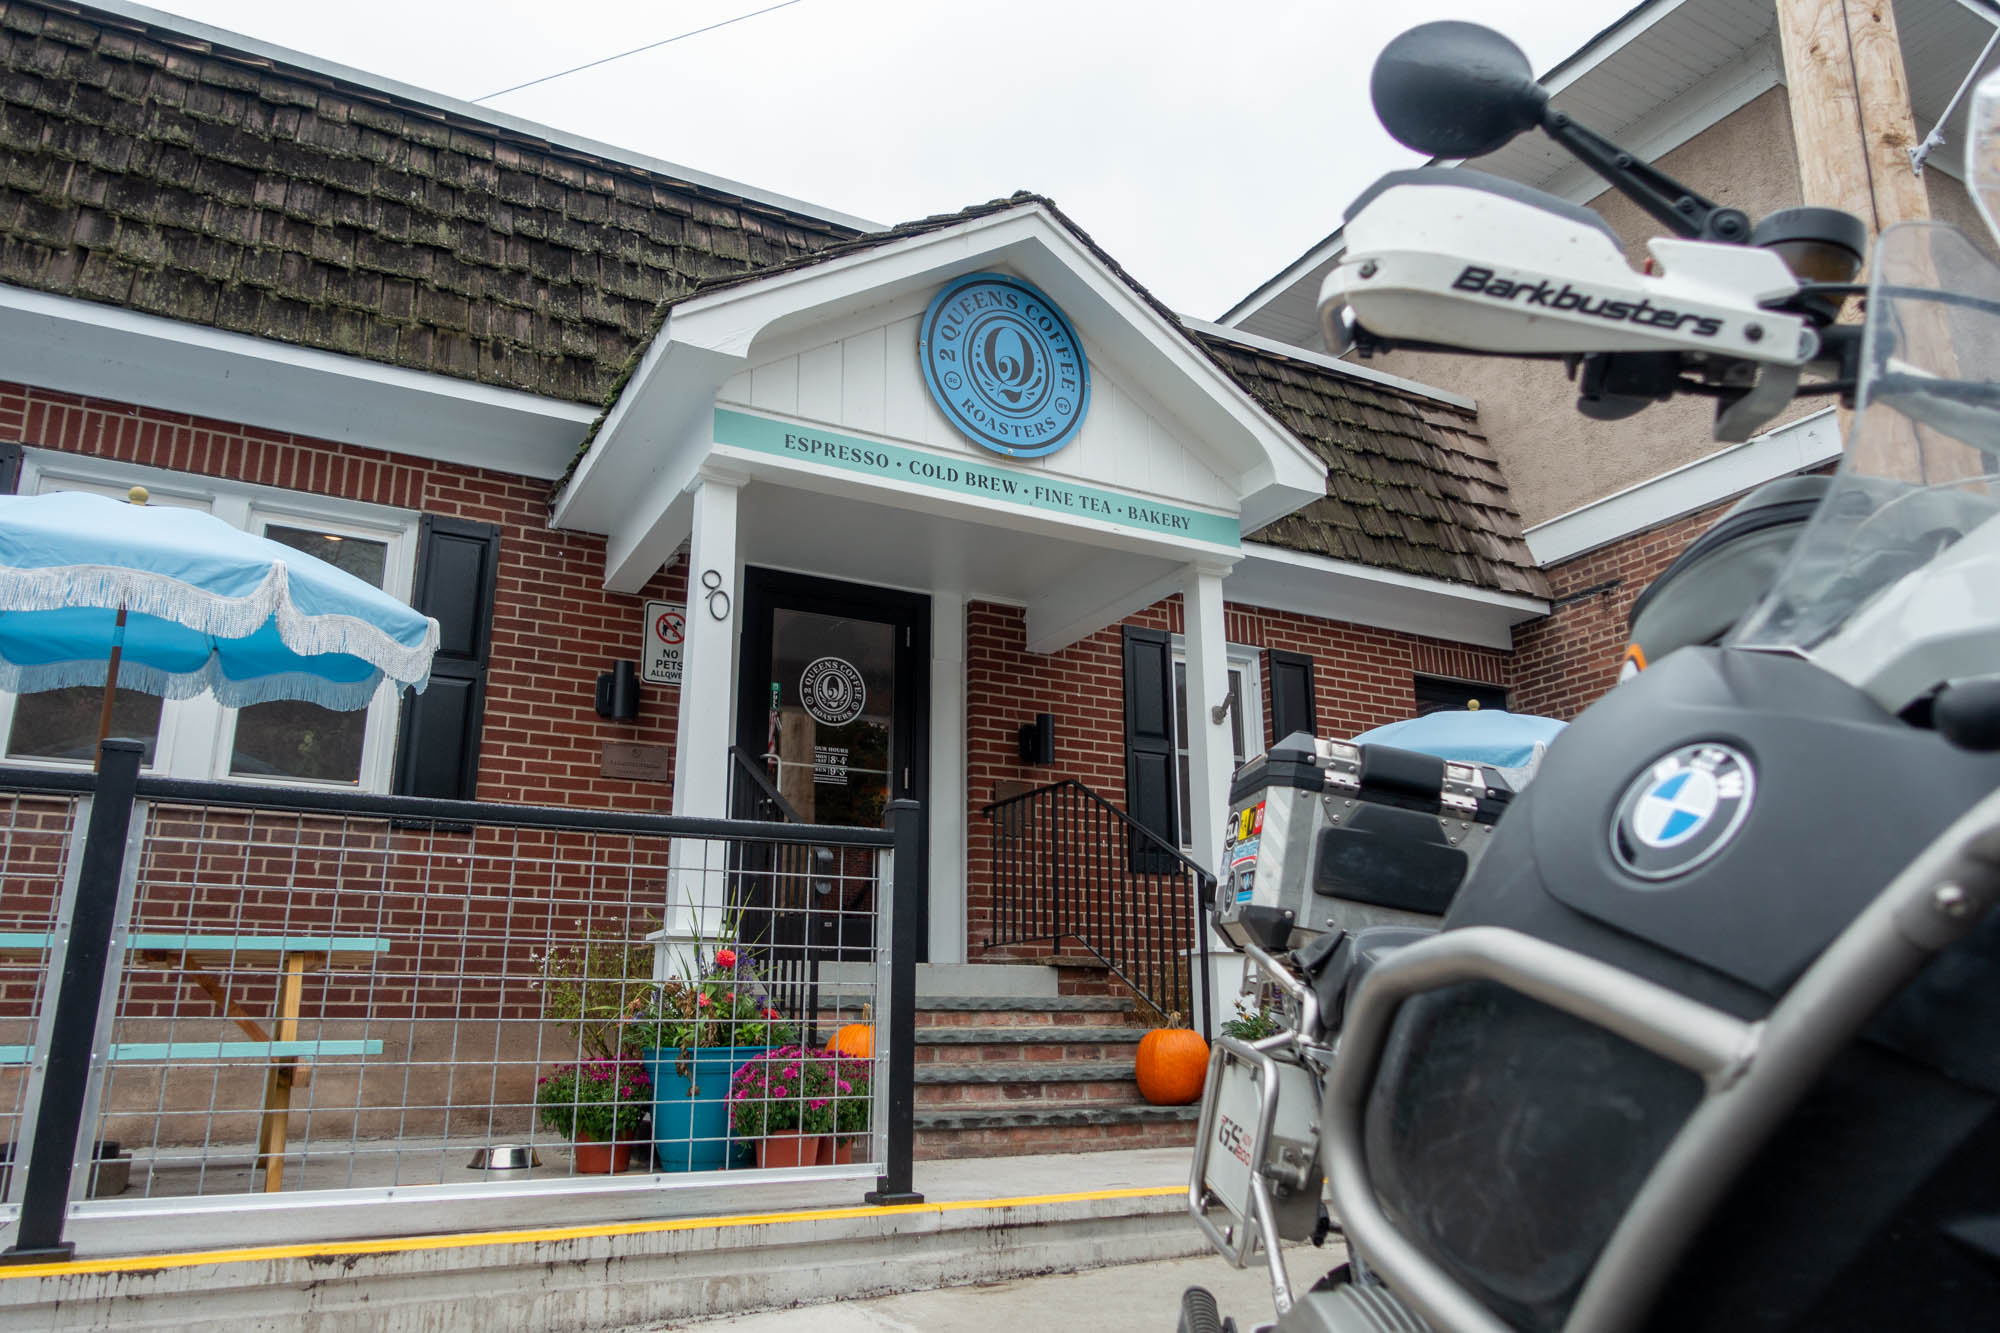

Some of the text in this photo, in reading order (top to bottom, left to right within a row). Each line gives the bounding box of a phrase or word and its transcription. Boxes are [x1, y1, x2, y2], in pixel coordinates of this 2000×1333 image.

[1452, 265, 1724, 337] Barkbusters
[940, 290, 1076, 392] 2 QUEENS COFFEE
[961, 397, 1057, 438] ROASTERS
[784, 433, 1191, 530] ESPRESSO COLD BREW FINE TEA BAKERY
[655, 659, 683, 671] PETS
[662, 649, 679, 659] NO
[650, 669, 683, 680] ALLOWE
[805, 661, 839, 685] QUEENS
[840, 664, 862, 700] COFFEE
[812, 706, 853, 722] ROASTERS
